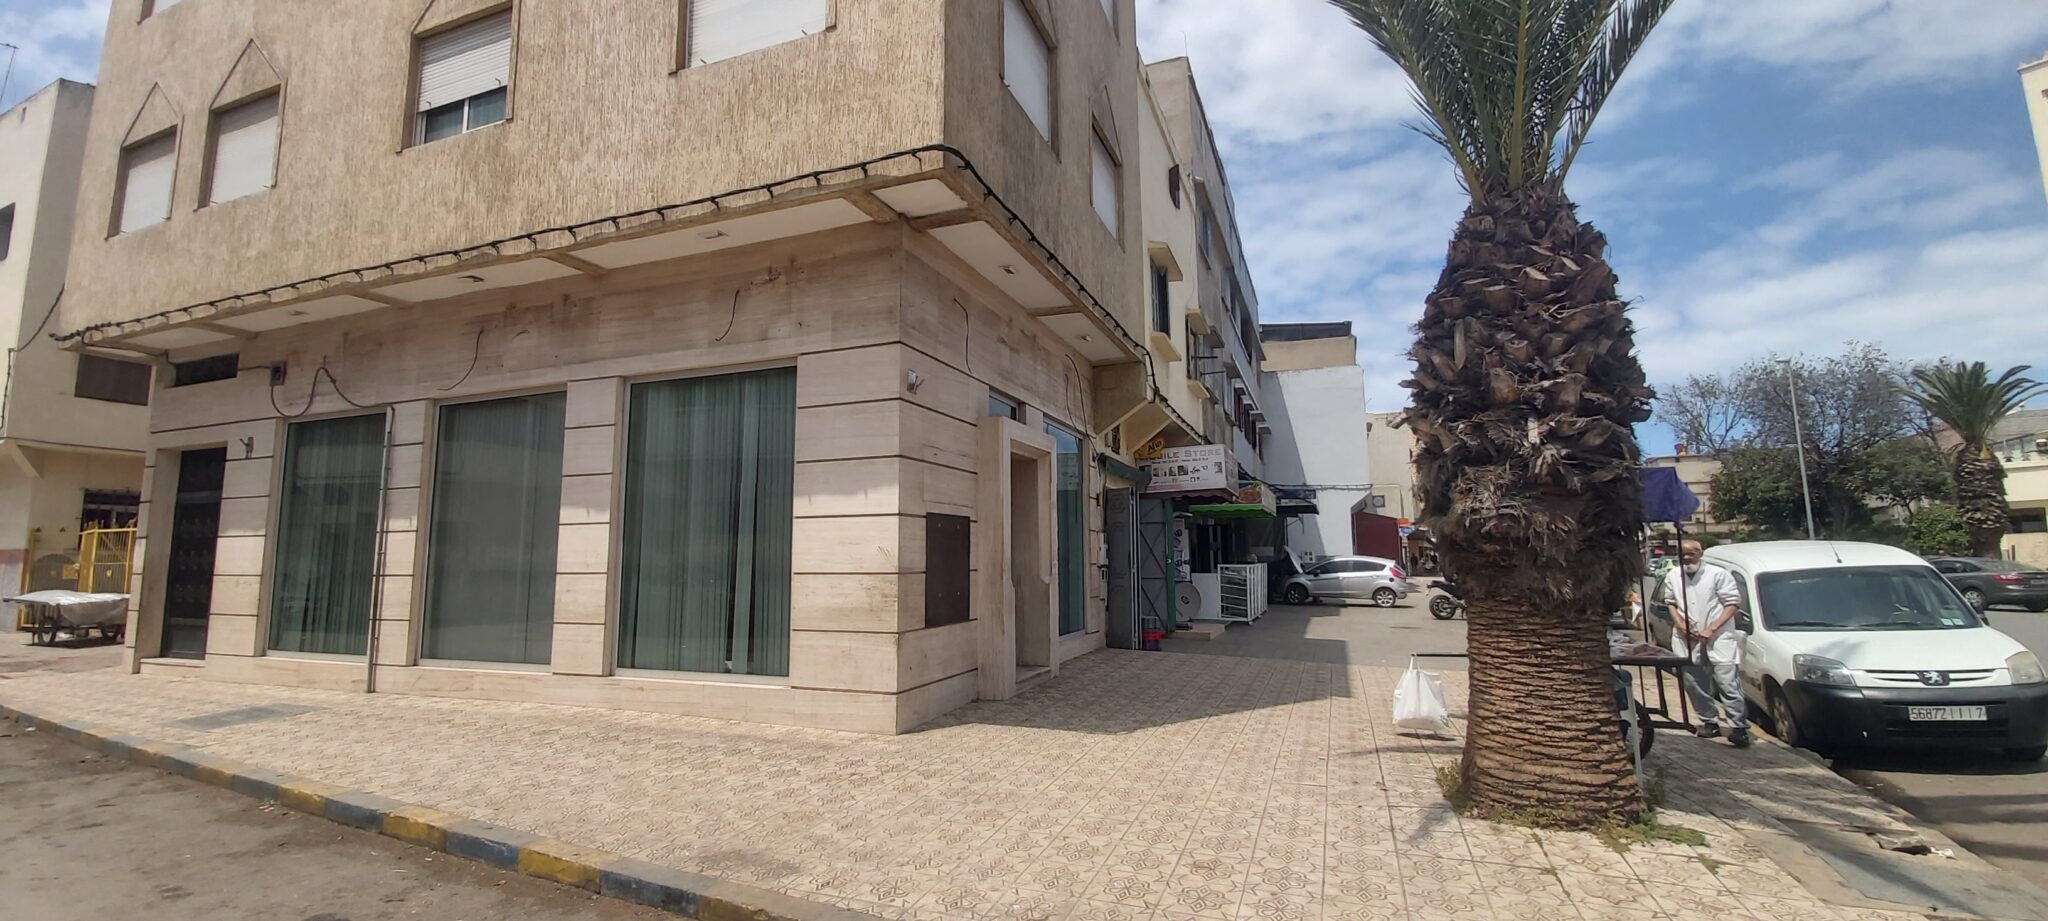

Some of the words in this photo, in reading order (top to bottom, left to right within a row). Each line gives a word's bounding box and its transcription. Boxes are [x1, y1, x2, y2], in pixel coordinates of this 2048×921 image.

[1184, 448, 1222, 458] STORE
[1911, 707, 1948, 720] 56872
[1975, 707, 1983, 719] 7
